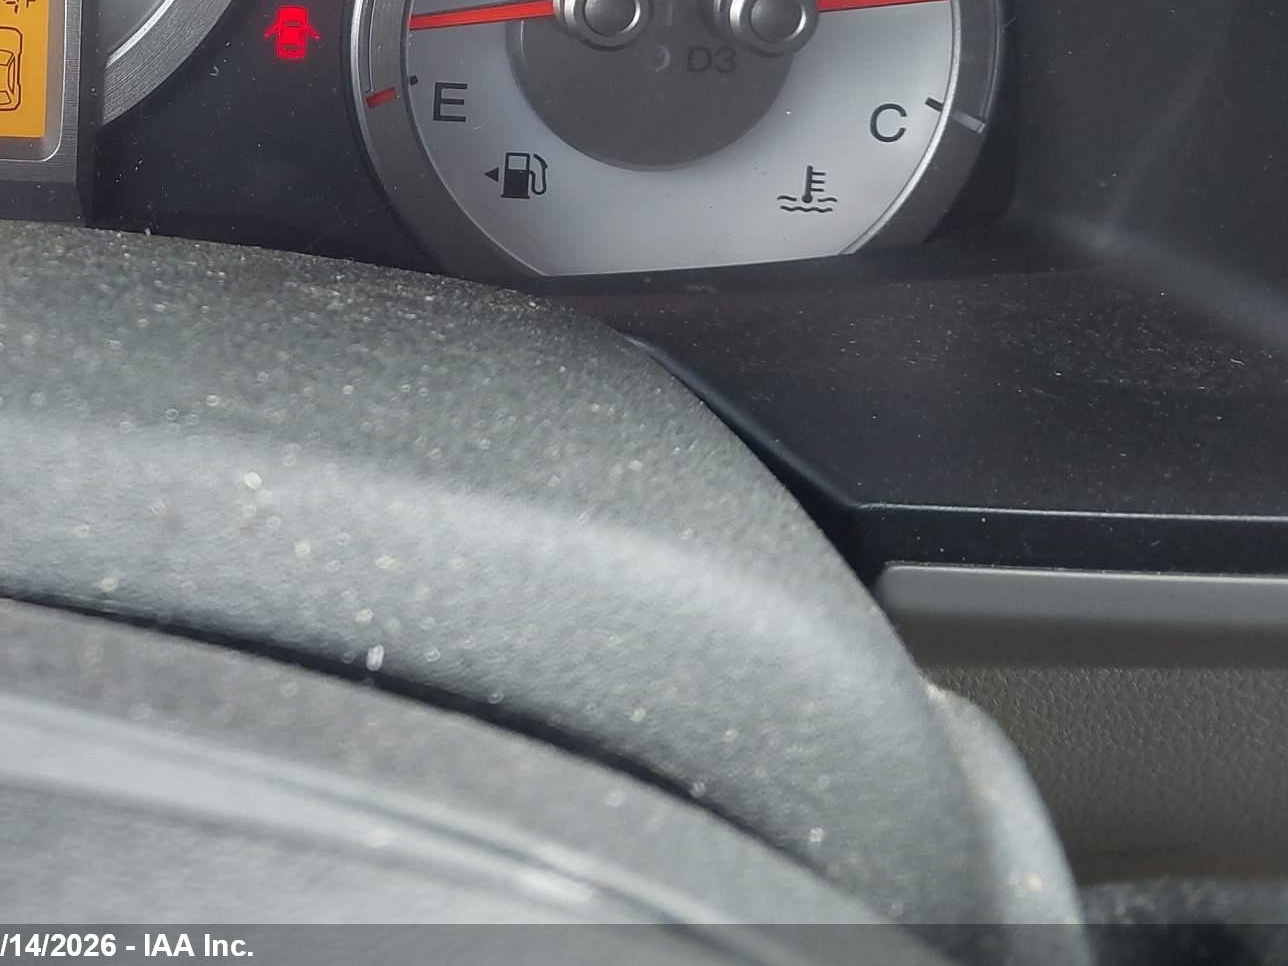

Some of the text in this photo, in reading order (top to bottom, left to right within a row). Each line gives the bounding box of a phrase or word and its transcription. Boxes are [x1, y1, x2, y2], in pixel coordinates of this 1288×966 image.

[687, 46, 737, 73] D3
[432, 81, 467, 123] E
[870, 103, 908, 143] C
